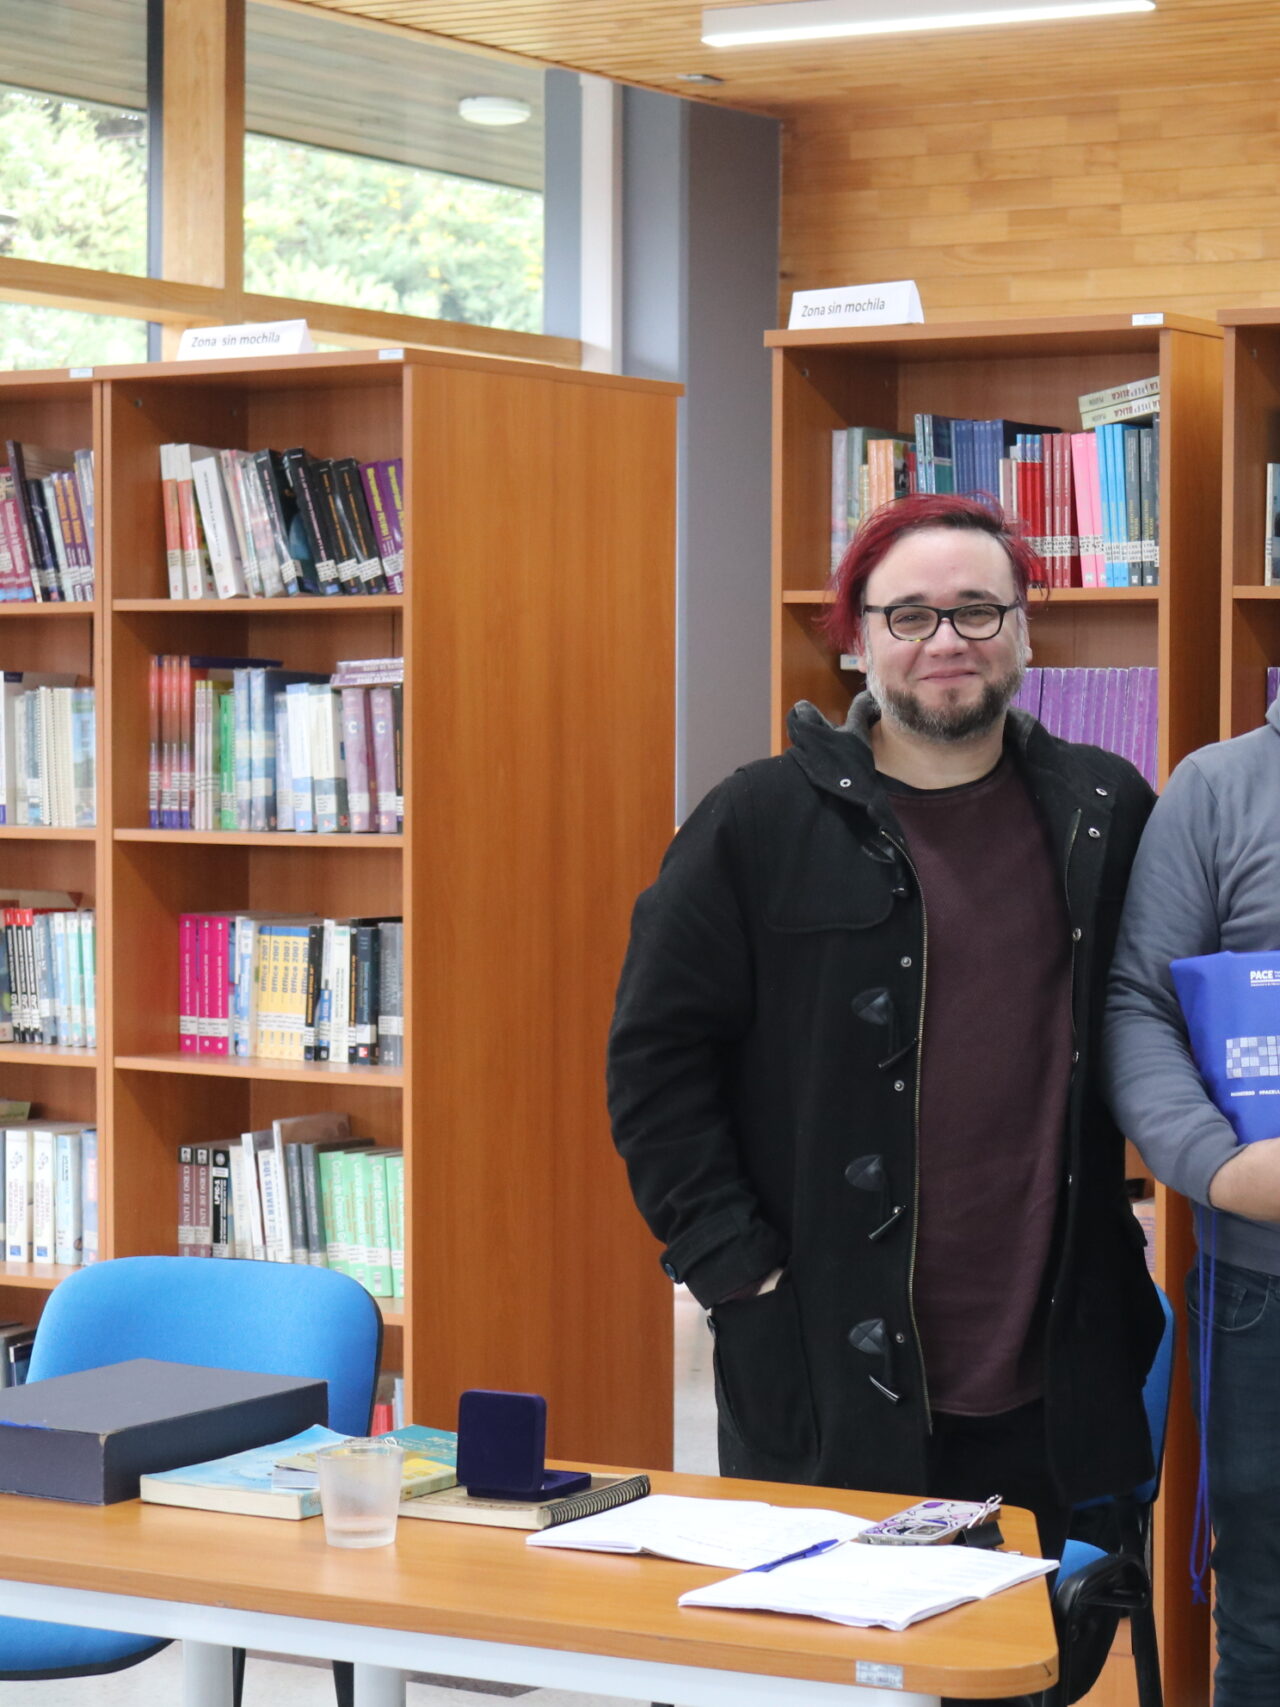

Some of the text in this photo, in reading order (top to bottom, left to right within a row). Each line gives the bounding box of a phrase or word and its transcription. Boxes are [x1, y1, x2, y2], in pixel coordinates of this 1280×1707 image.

[801, 297, 886, 318] Zona sin mochila
[191, 331, 281, 348] Zona sin mochila
[271, 940, 280, 993] Office 2007
[282, 940, 290, 994] Office 2007
[290, 940, 299, 994] Office 2007
[1250, 970, 1273, 980] PACE
[183, 1166, 191, 1204] CURSO DE
[199, 1167, 207, 1206] CURSO DE
